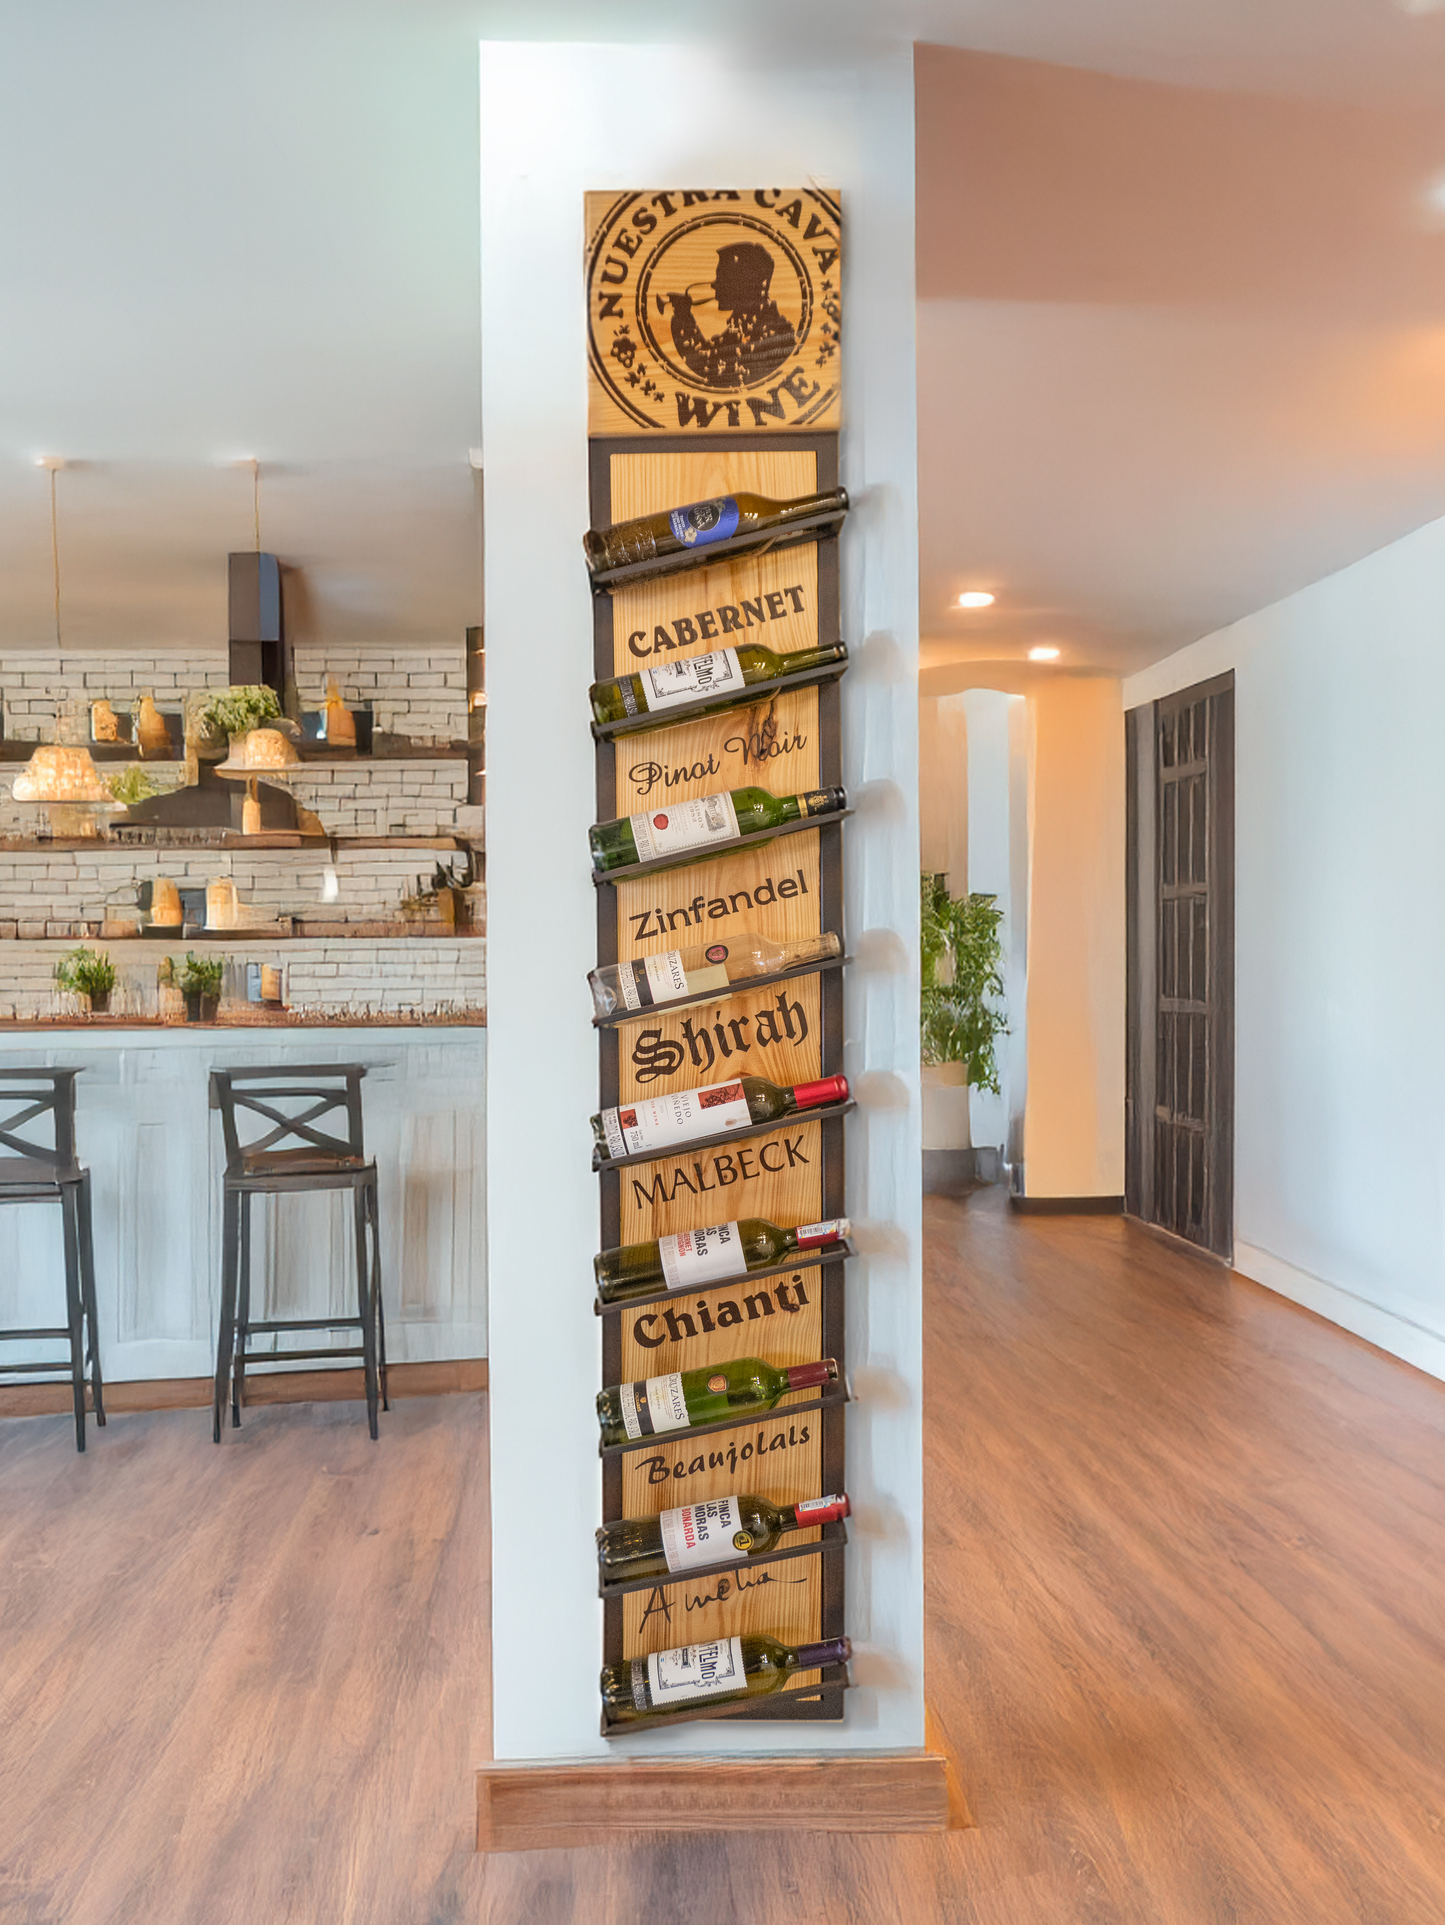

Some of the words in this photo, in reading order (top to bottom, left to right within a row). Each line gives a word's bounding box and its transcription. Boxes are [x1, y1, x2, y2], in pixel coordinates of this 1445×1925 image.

[754, 188, 838, 275] CAVA
[675, 366, 820, 428] WINE
[628, 584, 805, 657] CABERNET
[628, 753, 720, 795] Pinot
[724, 731, 807, 766] Noir
[629, 869, 809, 941] Zinfandel
[631, 991, 808, 1084] Shirah
[671, 1094, 684, 1125] VIÑEDO
[681, 1094, 692, 1118] VIEJO
[630, 1131, 640, 1142] 750
[632, 1135, 810, 1210] MALBECK
[677, 1233, 686, 1257] UVIGNON
[684, 1232, 692, 1252] BERNET
[633, 1274, 810, 1349] Chianti
[669, 1374, 686, 1420] CRUZARES
[682, 1508, 696, 1549] BONARDA
[694, 1504, 710, 1541] MORAS
[706, 1502, 718, 1518] LAS
[718, 1500, 732, 1528] FINCA
